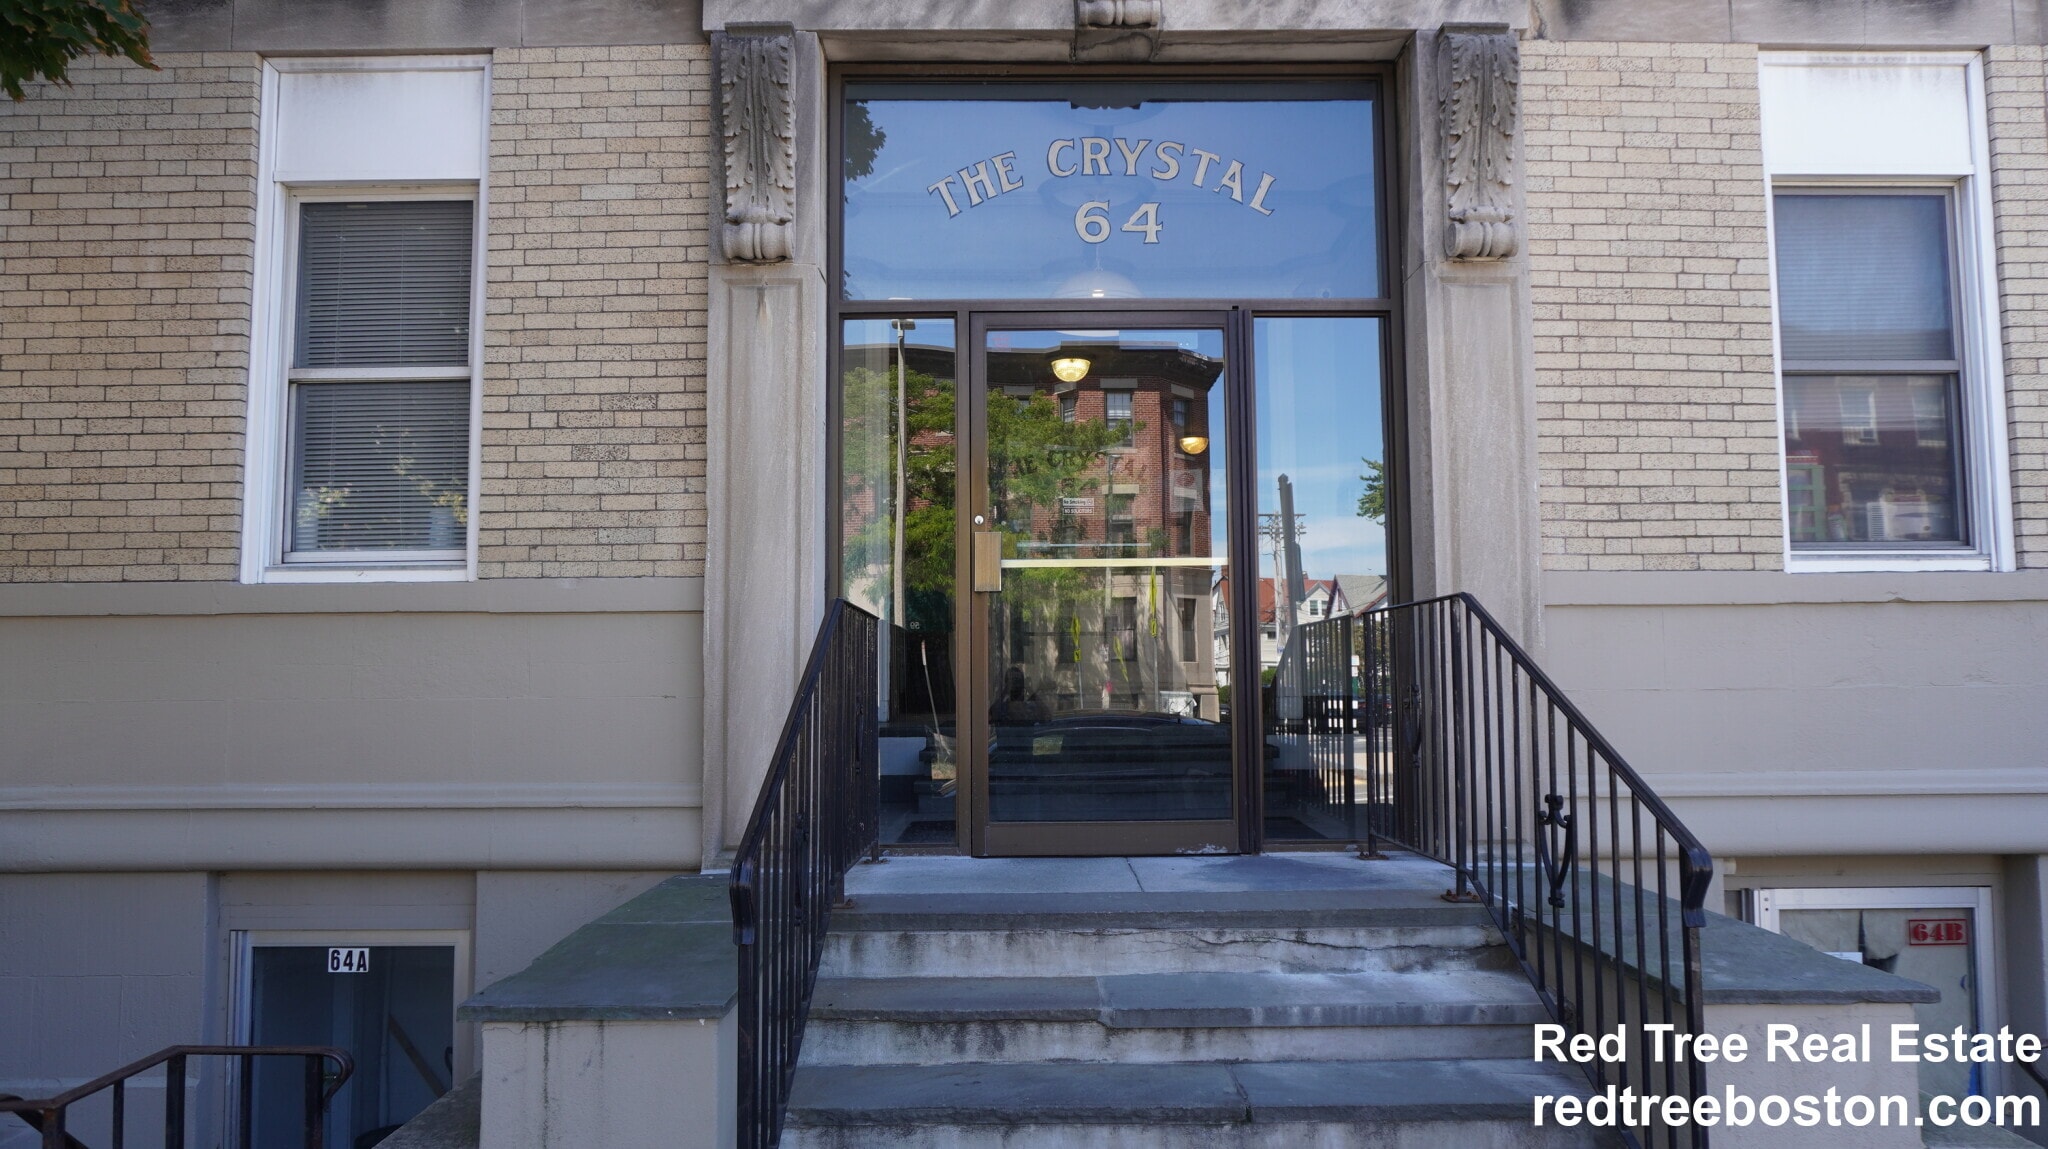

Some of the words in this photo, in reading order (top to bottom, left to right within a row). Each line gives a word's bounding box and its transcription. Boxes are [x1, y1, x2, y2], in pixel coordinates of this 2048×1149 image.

[927, 151, 1025, 220] THE
[1046, 137, 1276, 217] CRYSTAL
[1074, 200, 1163, 245] 64
[1913, 922, 1963, 942] 64B
[330, 949, 367, 972] 64A
